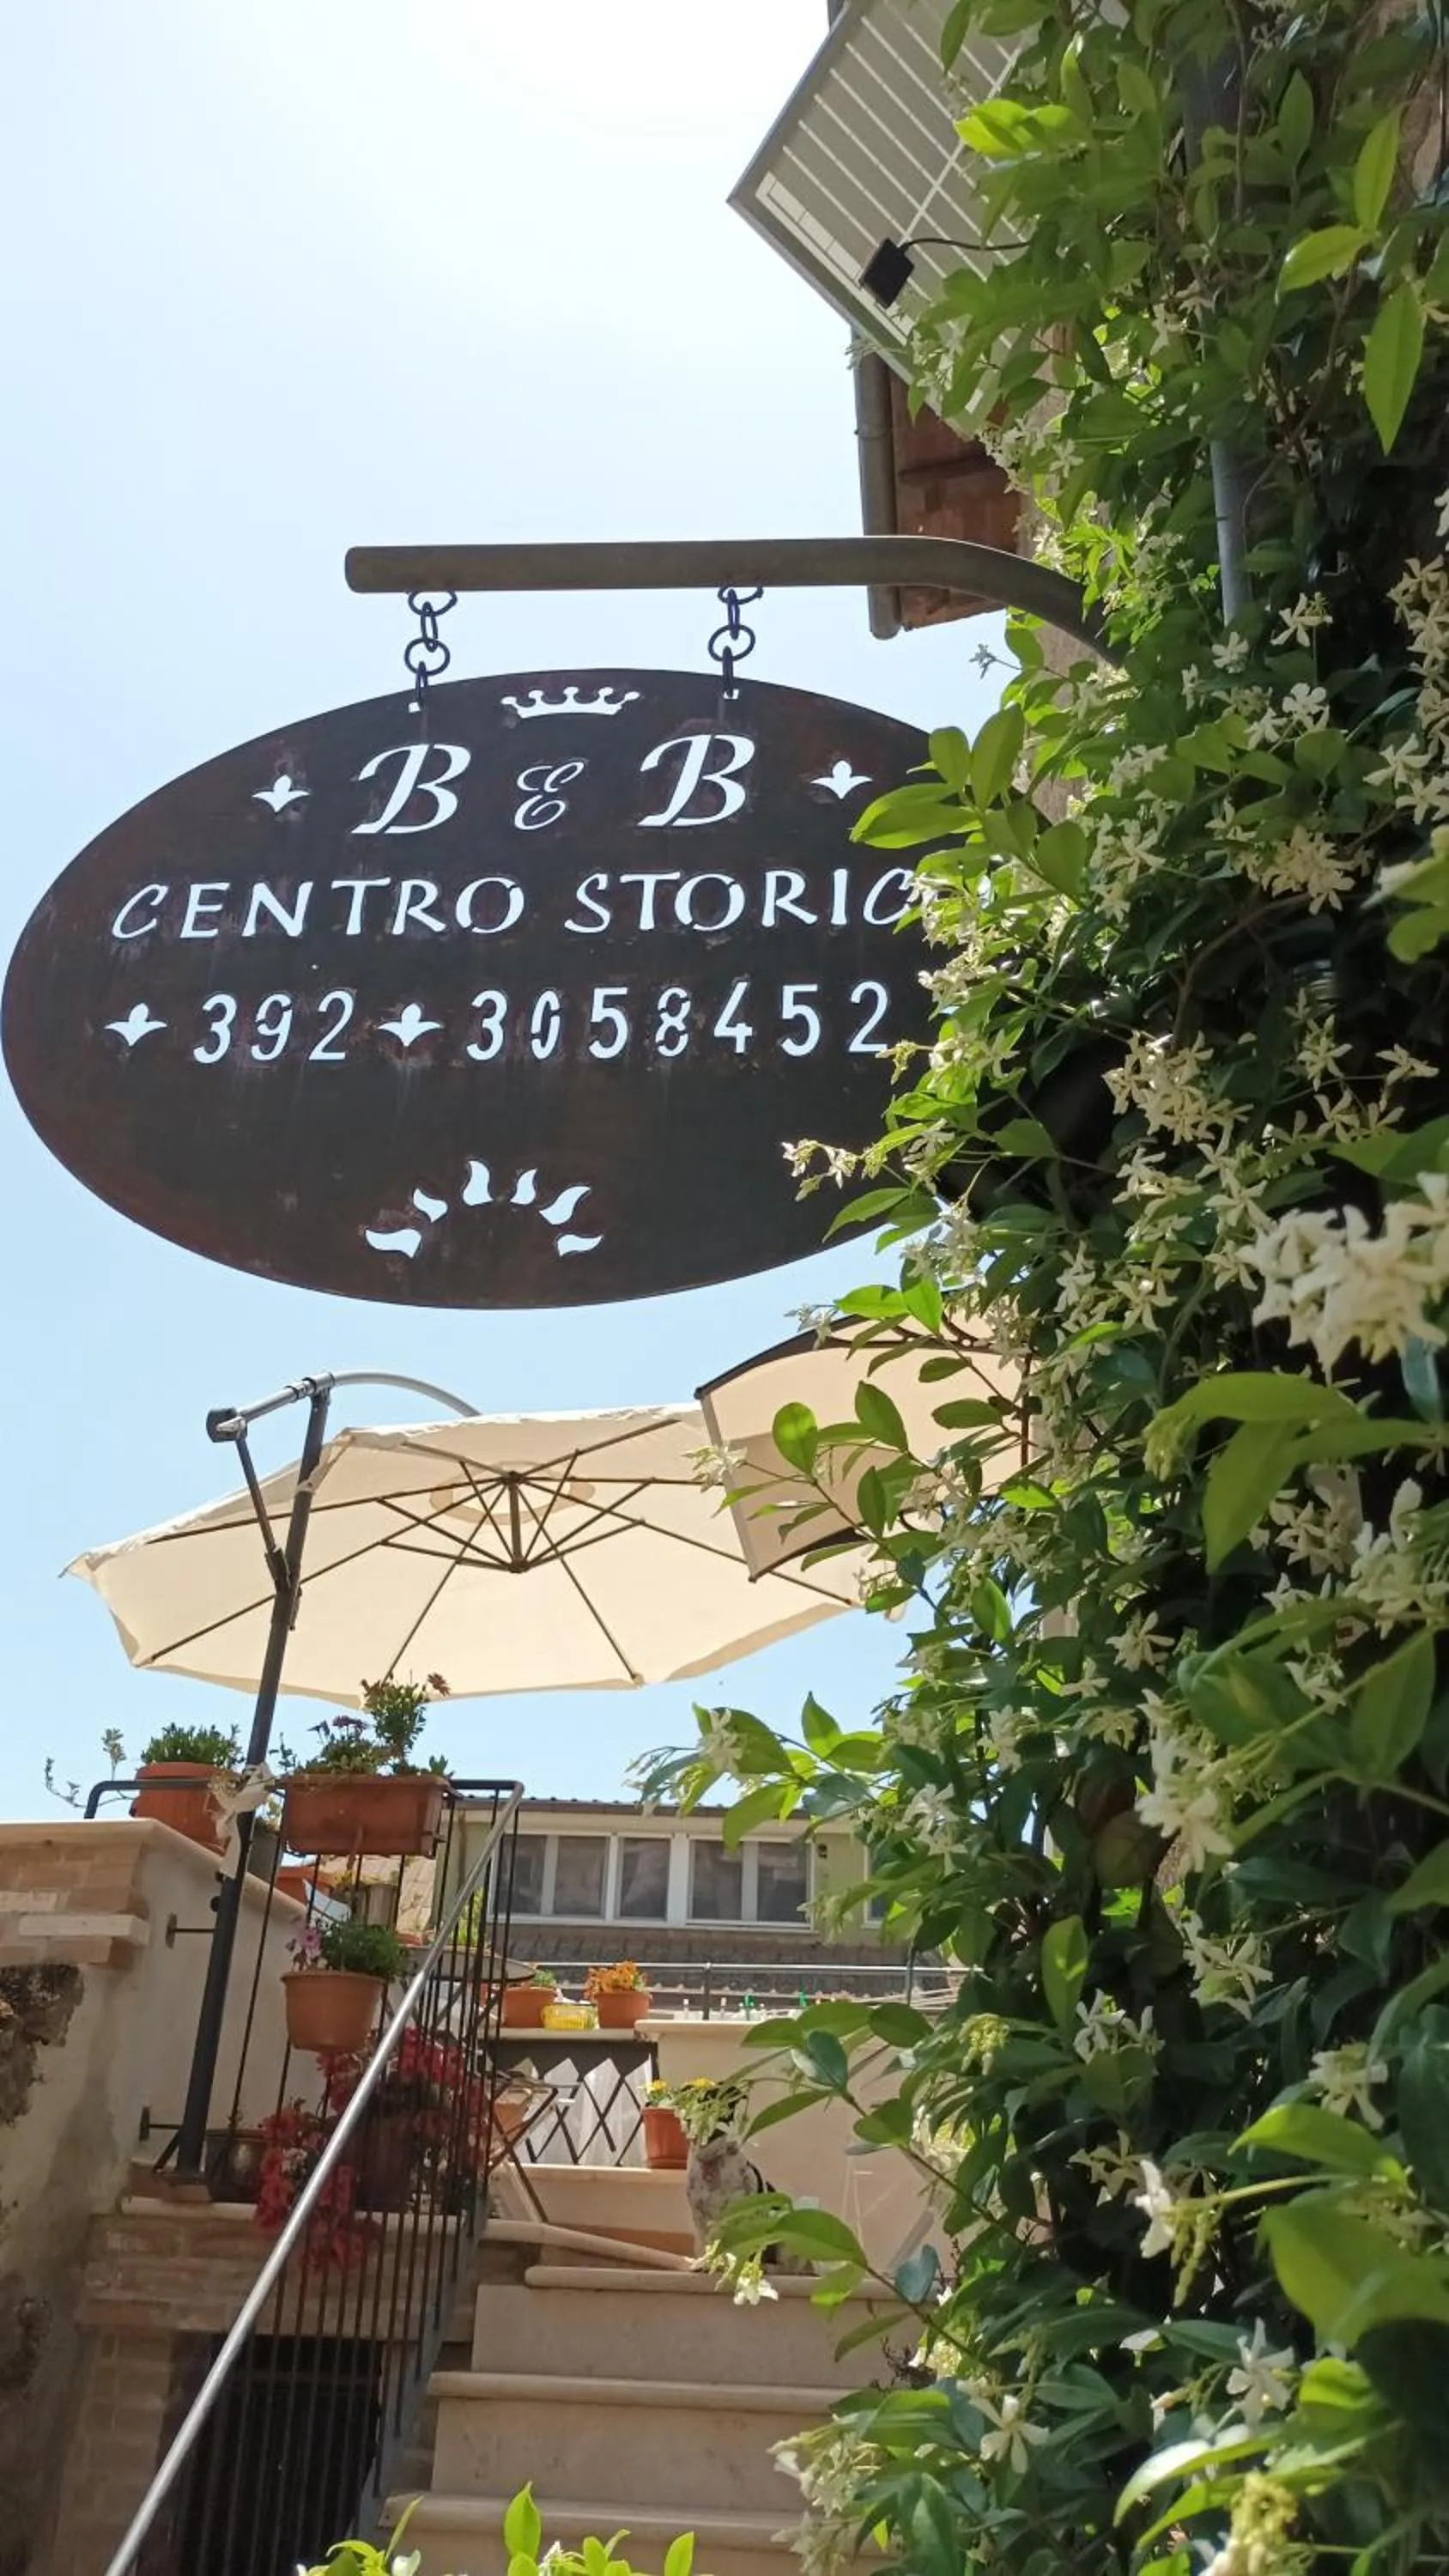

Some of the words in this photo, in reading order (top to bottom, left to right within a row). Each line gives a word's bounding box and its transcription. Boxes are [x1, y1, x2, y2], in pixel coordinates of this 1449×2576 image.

[351, 743, 471, 834] B
[637, 733, 755, 827] B
[111, 876, 524, 939] CENTRO
[563, 866, 993, 934] STORIC
[192, 990, 355, 1064] 392
[466, 980, 890, 1061] 3058452
